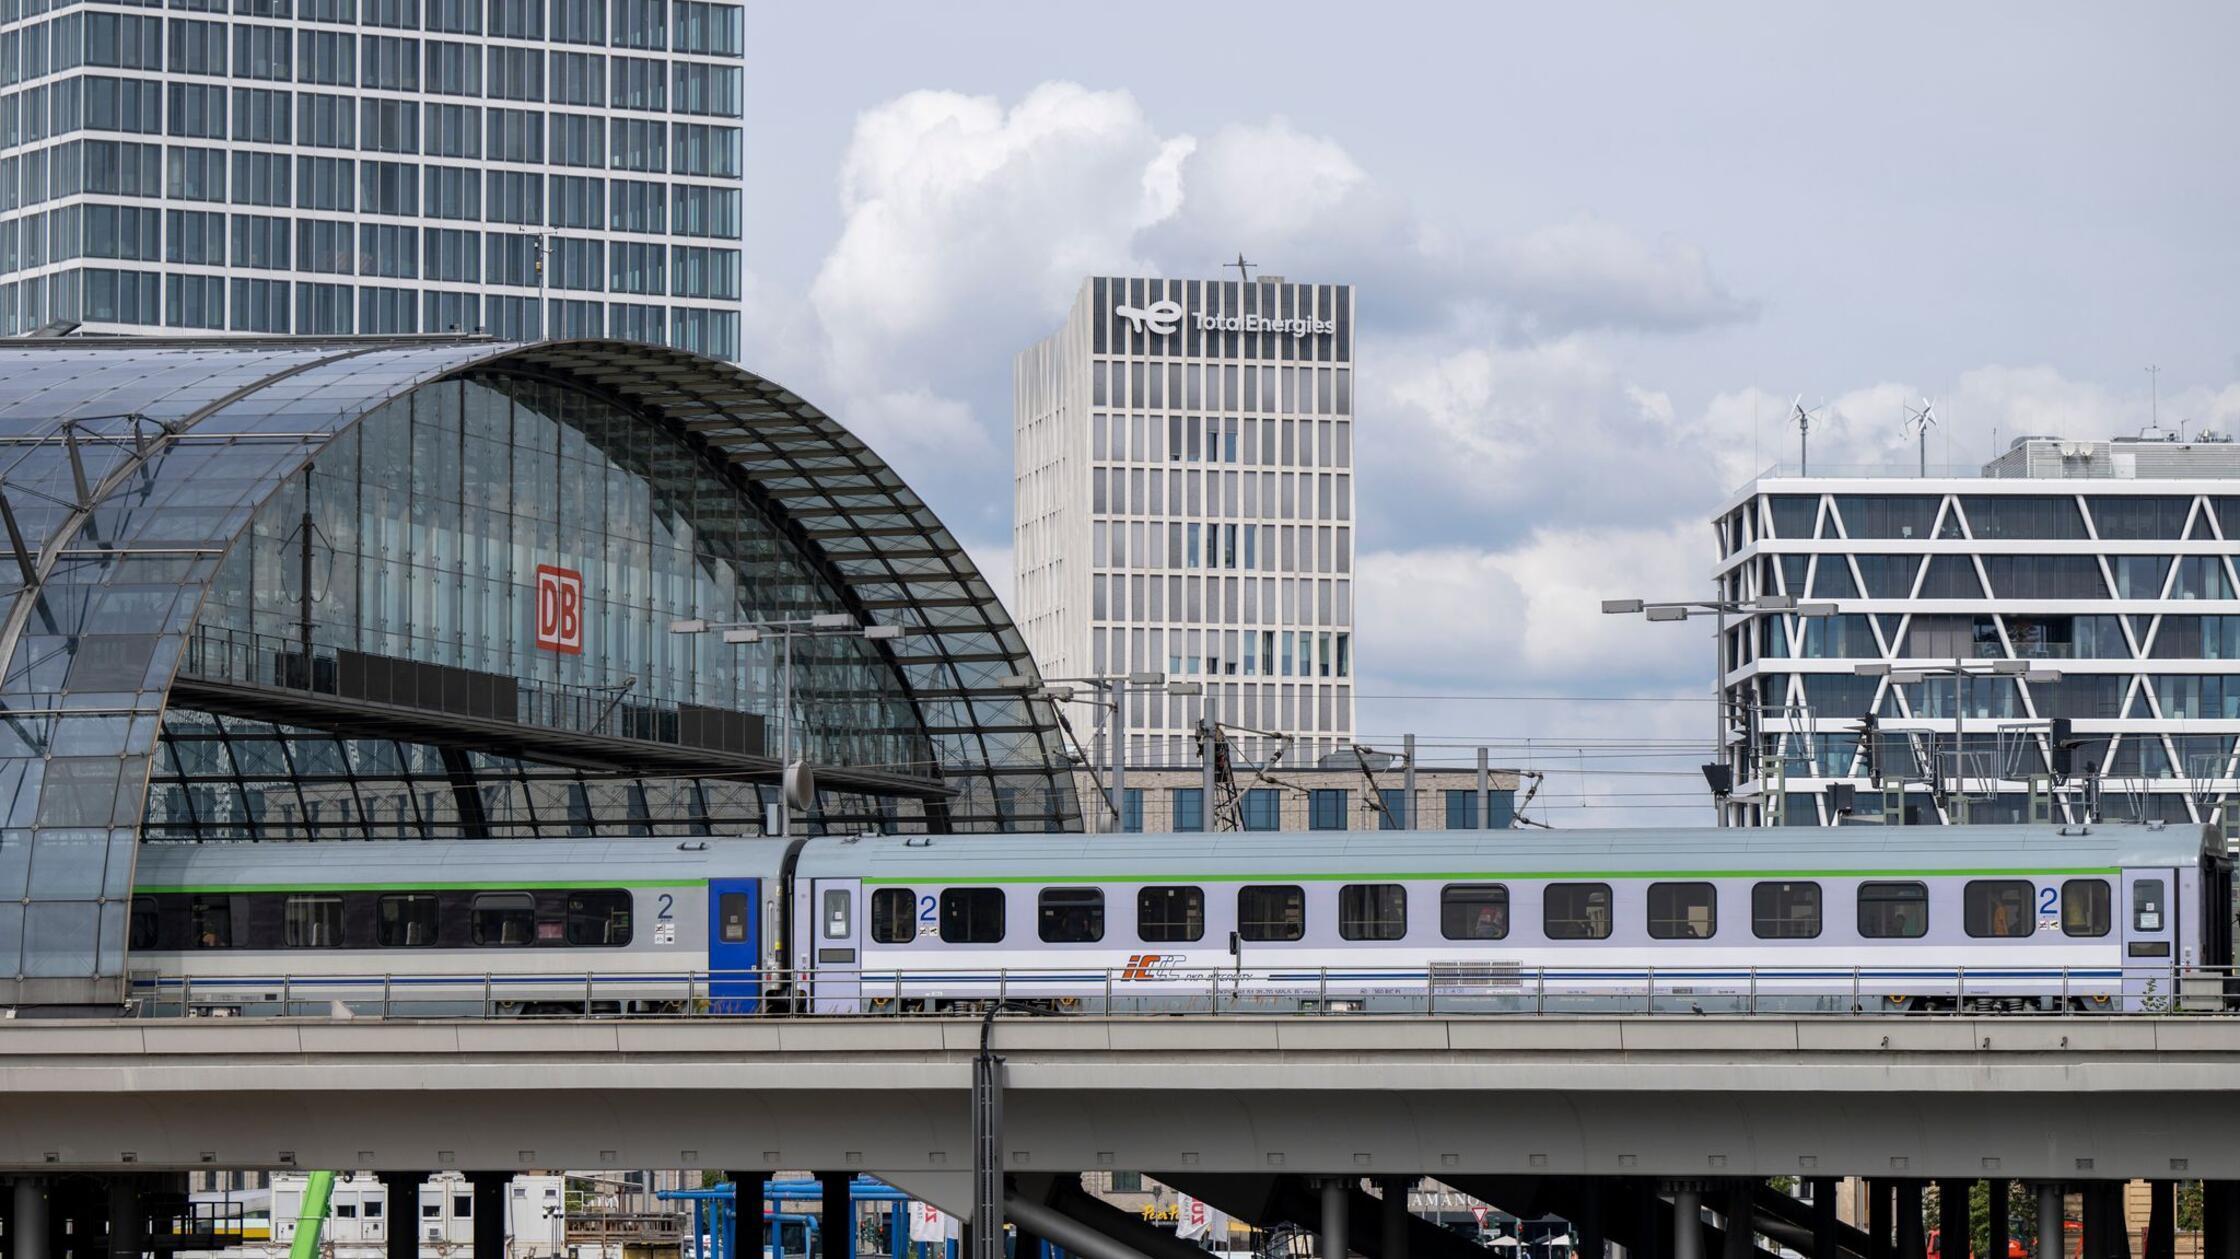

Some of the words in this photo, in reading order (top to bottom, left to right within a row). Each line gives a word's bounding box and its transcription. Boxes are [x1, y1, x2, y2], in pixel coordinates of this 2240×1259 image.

[541, 579, 577, 640] DB
[658, 893, 674, 919] 2
[920, 895, 937, 921] 2
[2040, 887, 2058, 914] 2
[1141, 1204, 1168, 1221] Peer
